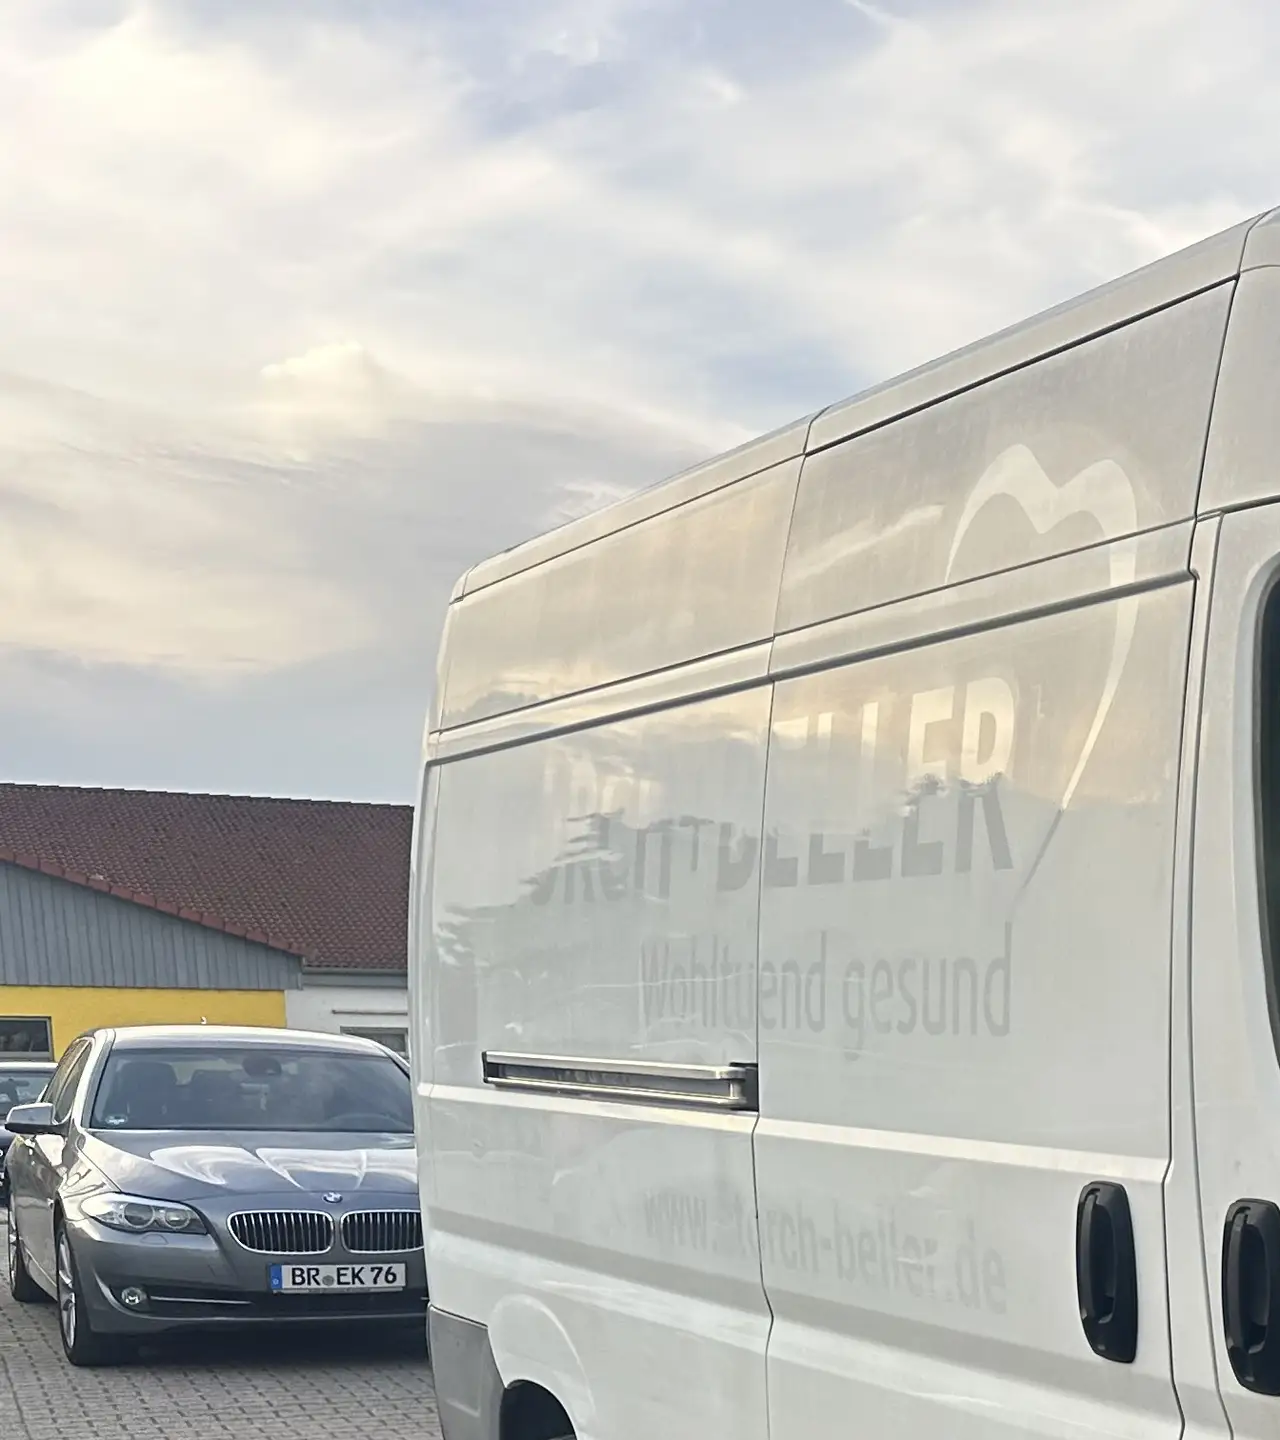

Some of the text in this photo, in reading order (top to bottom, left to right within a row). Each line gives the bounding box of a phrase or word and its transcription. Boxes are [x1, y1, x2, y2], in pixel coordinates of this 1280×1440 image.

[641, 920, 1012, 1061] Wohltuend gesund
[291, 1266, 397, 1286] BR EK 76
